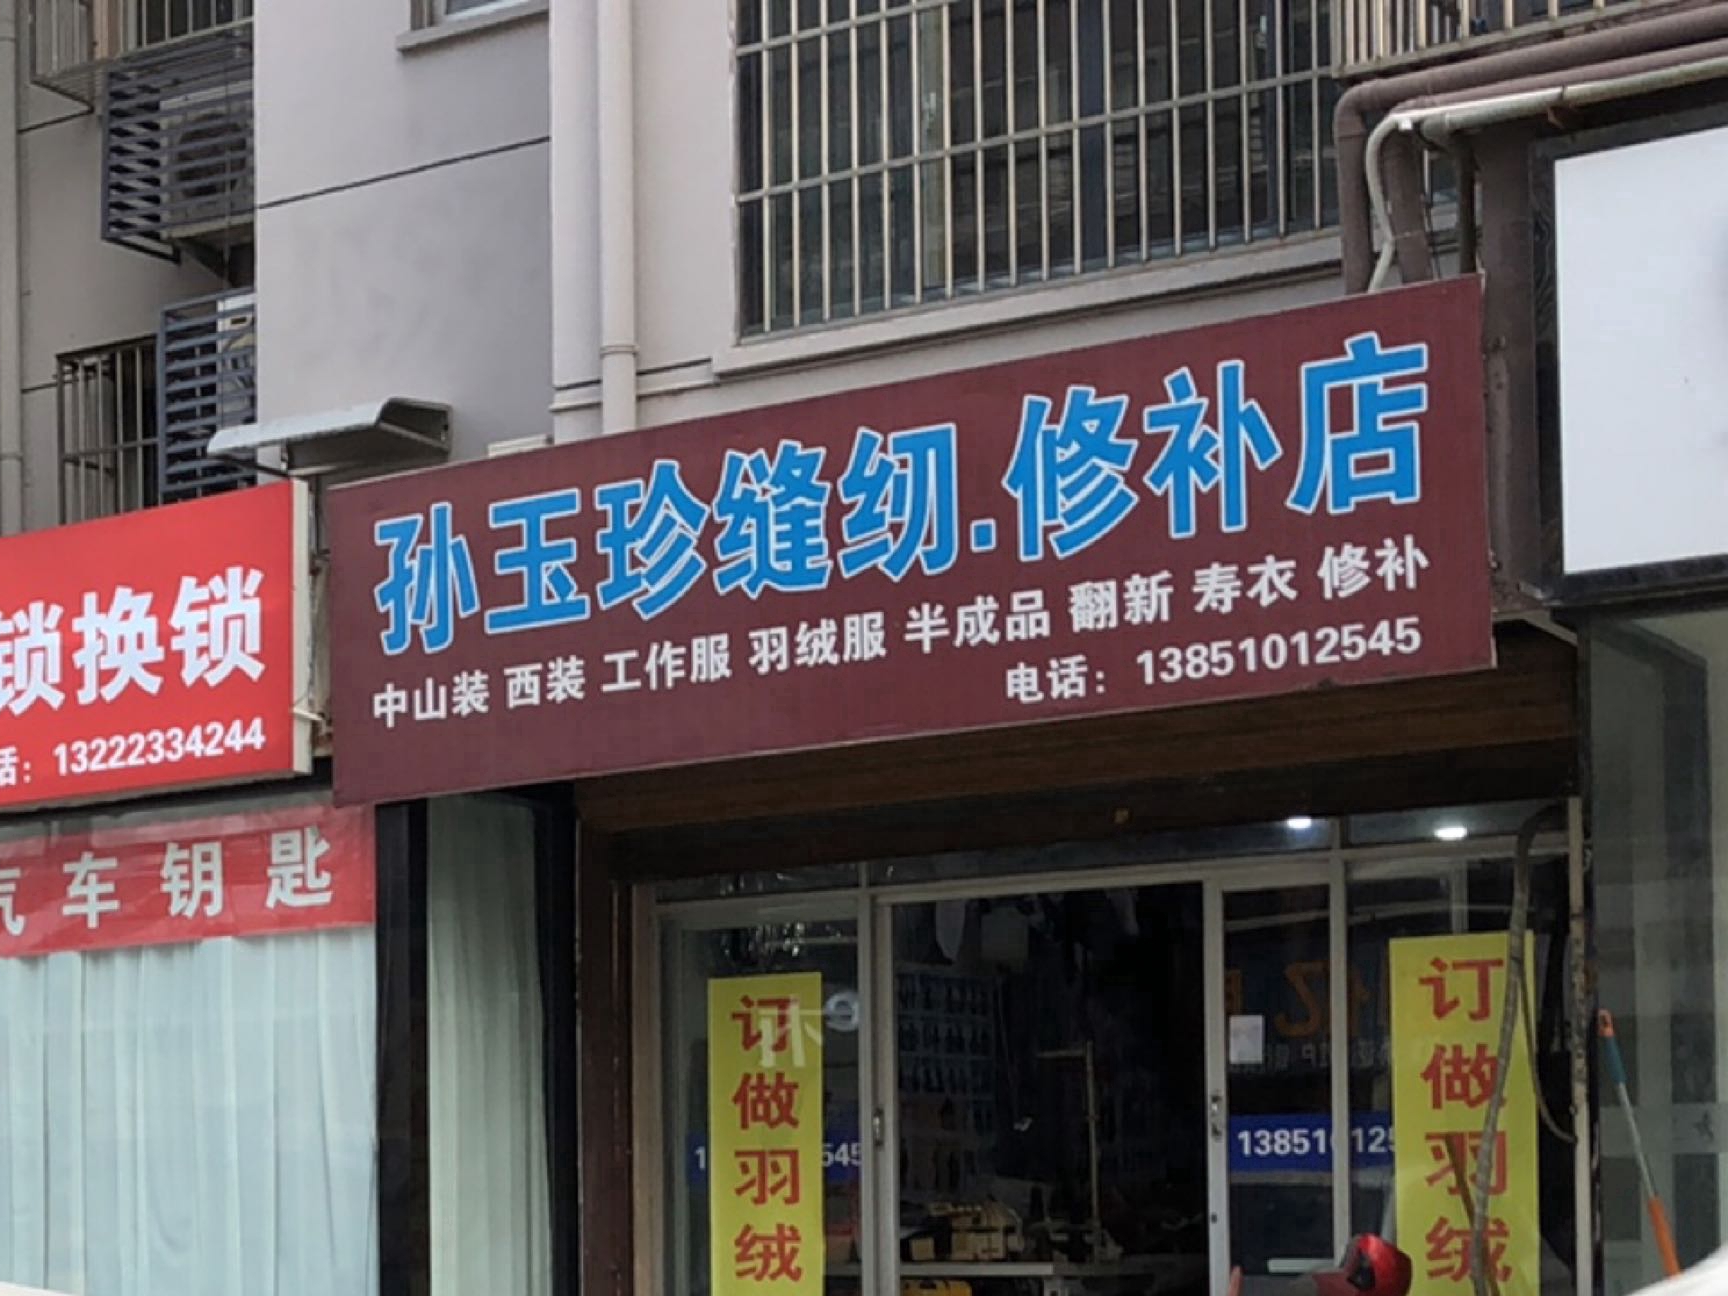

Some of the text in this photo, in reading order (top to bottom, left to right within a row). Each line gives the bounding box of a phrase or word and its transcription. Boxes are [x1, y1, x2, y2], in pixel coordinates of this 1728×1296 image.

[373, 332, 1429, 655] 孙玉珍缝纫.修补店
[373, 534, 1429, 728] 中山装 西装 工作服 羽绒服 半成品 翻新 寿衣 修补
[1136, 617, 1421, 685] 13851012545
[53, 717, 267, 776] 13222334244
